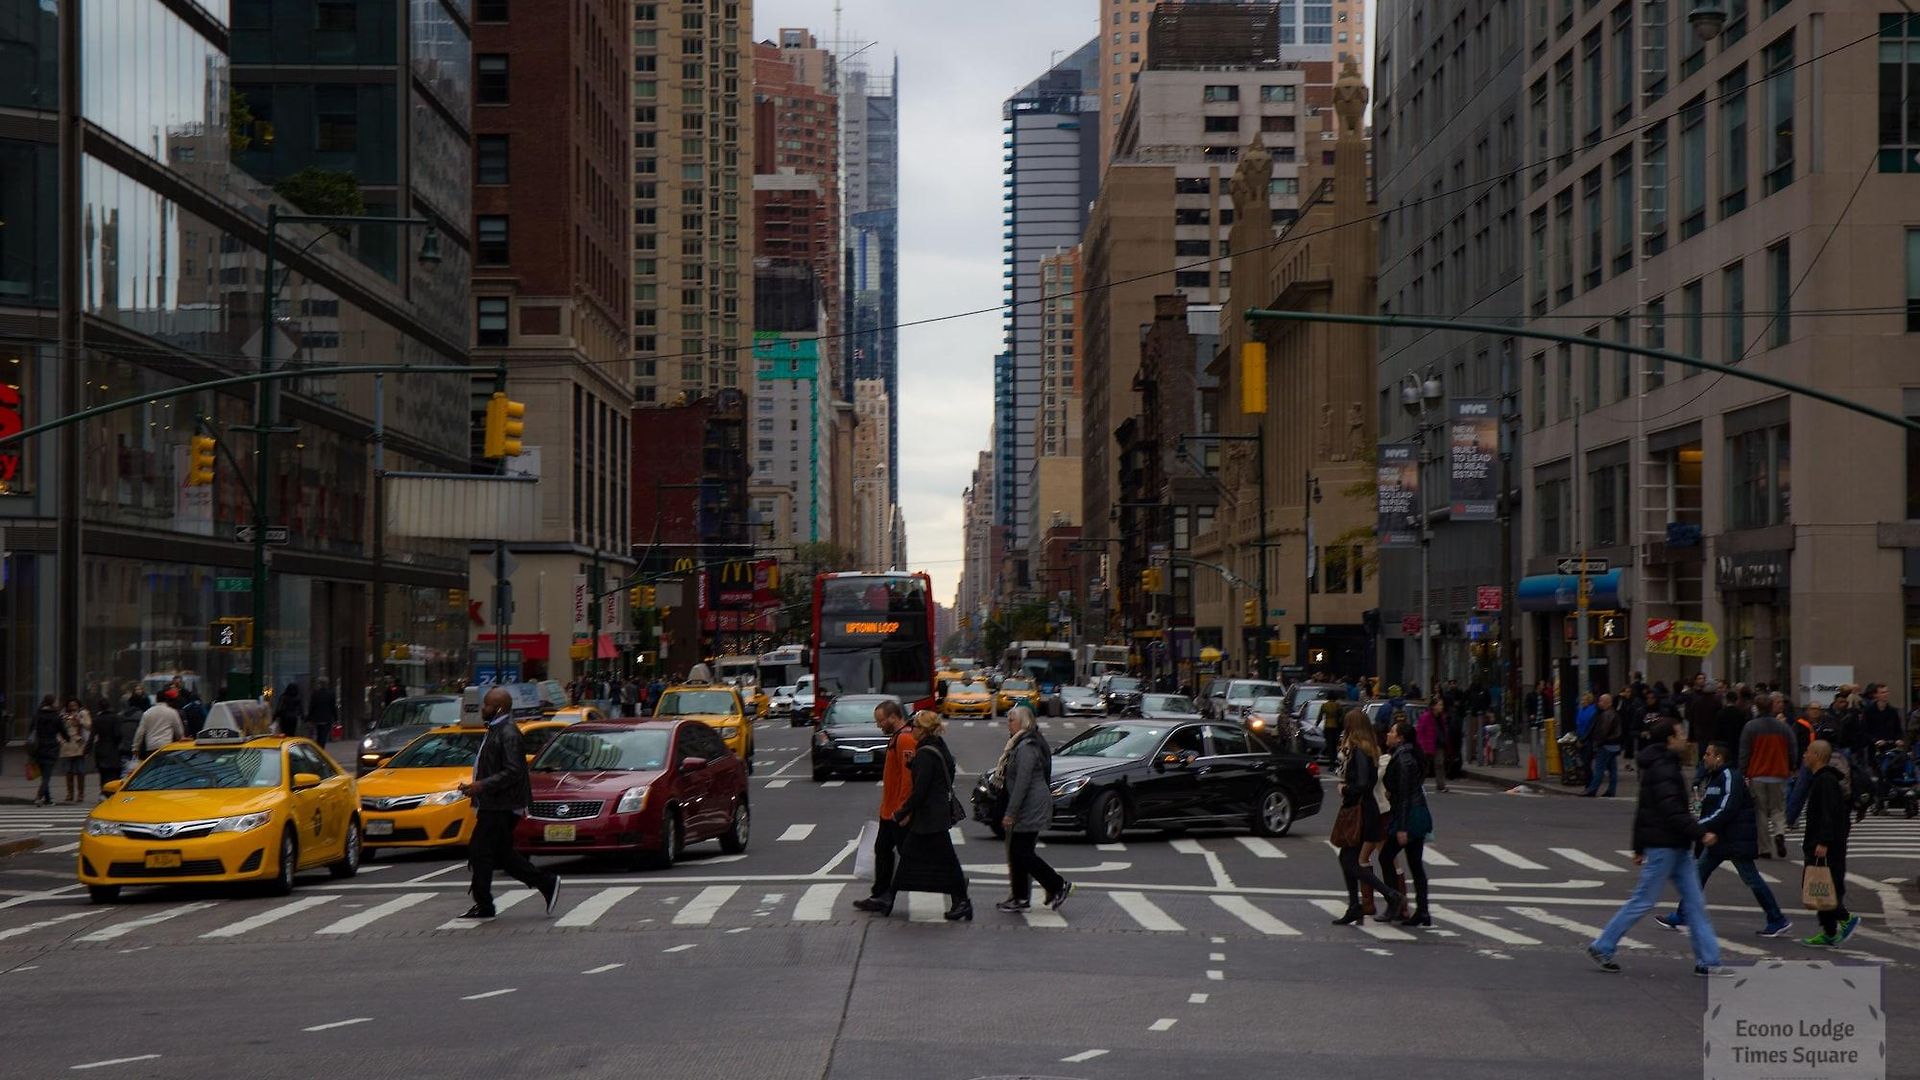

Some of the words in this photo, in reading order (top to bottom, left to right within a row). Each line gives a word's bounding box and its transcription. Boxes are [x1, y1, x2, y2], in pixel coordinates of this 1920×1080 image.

[1459, 404, 1488, 414] NYC
[1384, 449, 1409, 458] NYC
[1453, 454, 1466, 462] TO
[1467, 454, 1492, 462] LEAD
[845, 622, 877, 634] UPTOWN
[878, 622, 900, 634] LOOP
